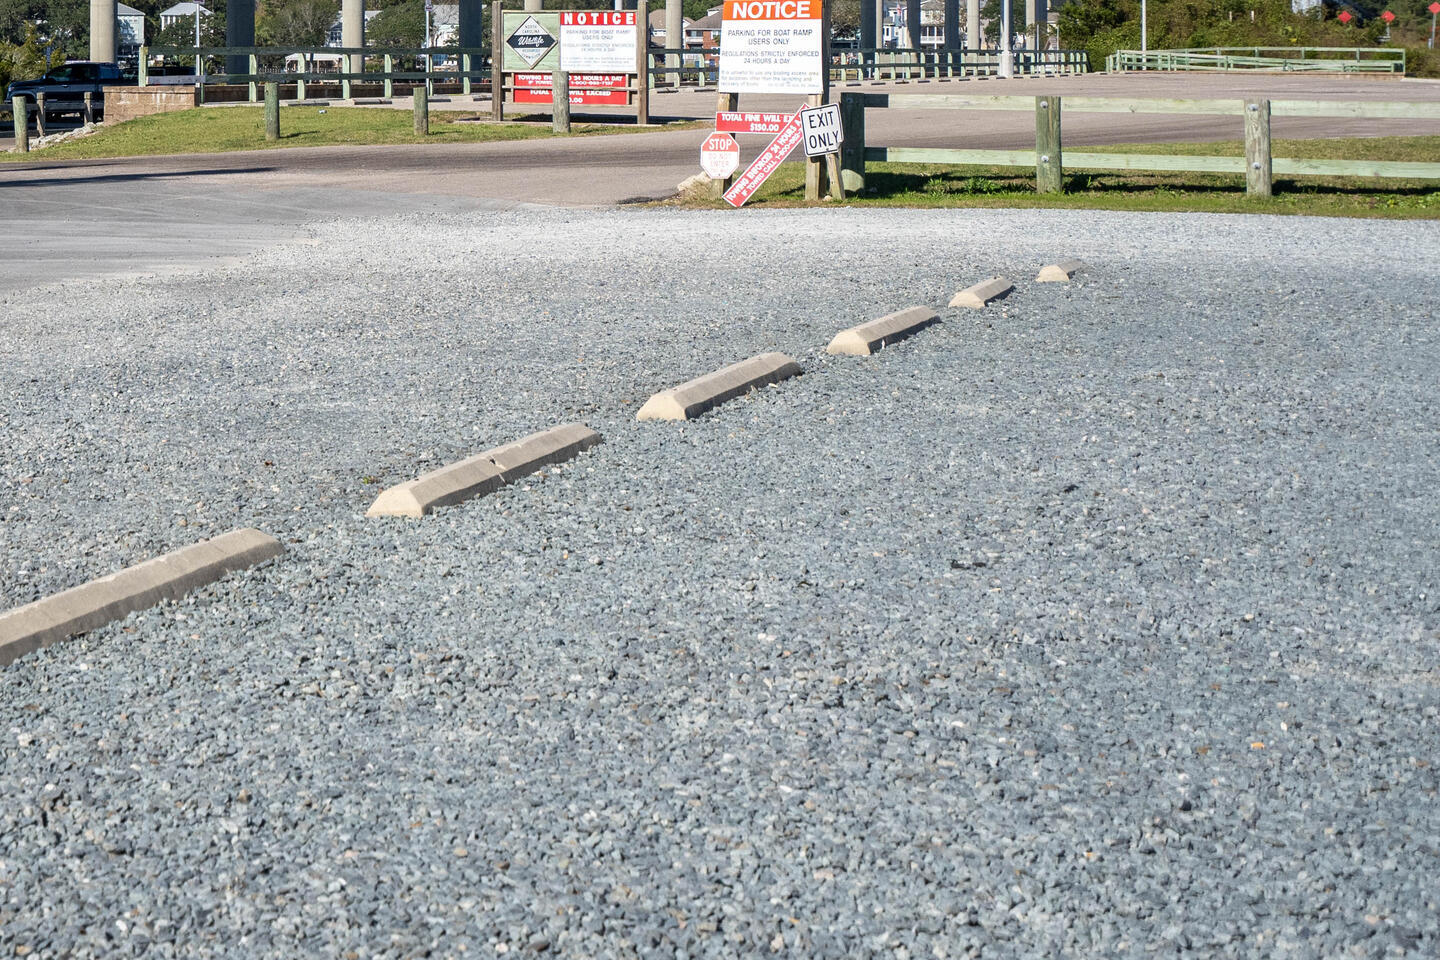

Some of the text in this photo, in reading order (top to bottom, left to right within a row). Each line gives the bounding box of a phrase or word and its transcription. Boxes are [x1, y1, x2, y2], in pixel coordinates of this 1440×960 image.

[732, 1, 811, 19] NOTICE
[564, 13, 634, 24] NOTICE
[518, 36, 544, 48] Wildlife
[764, 114, 781, 122] WILL
[808, 111, 834, 129] EXIT
[750, 123, 780, 131] $150.00
[708, 139, 732, 150] STOP
[810, 130, 839, 148] ONLY
[727, 178, 749, 200] TOWING
[746, 152, 774, 177] ENFORCED
[778, 126, 797, 145] HOURS
[748, 173, 764, 190] TOWED
[764, 160, 777, 173] CALL
